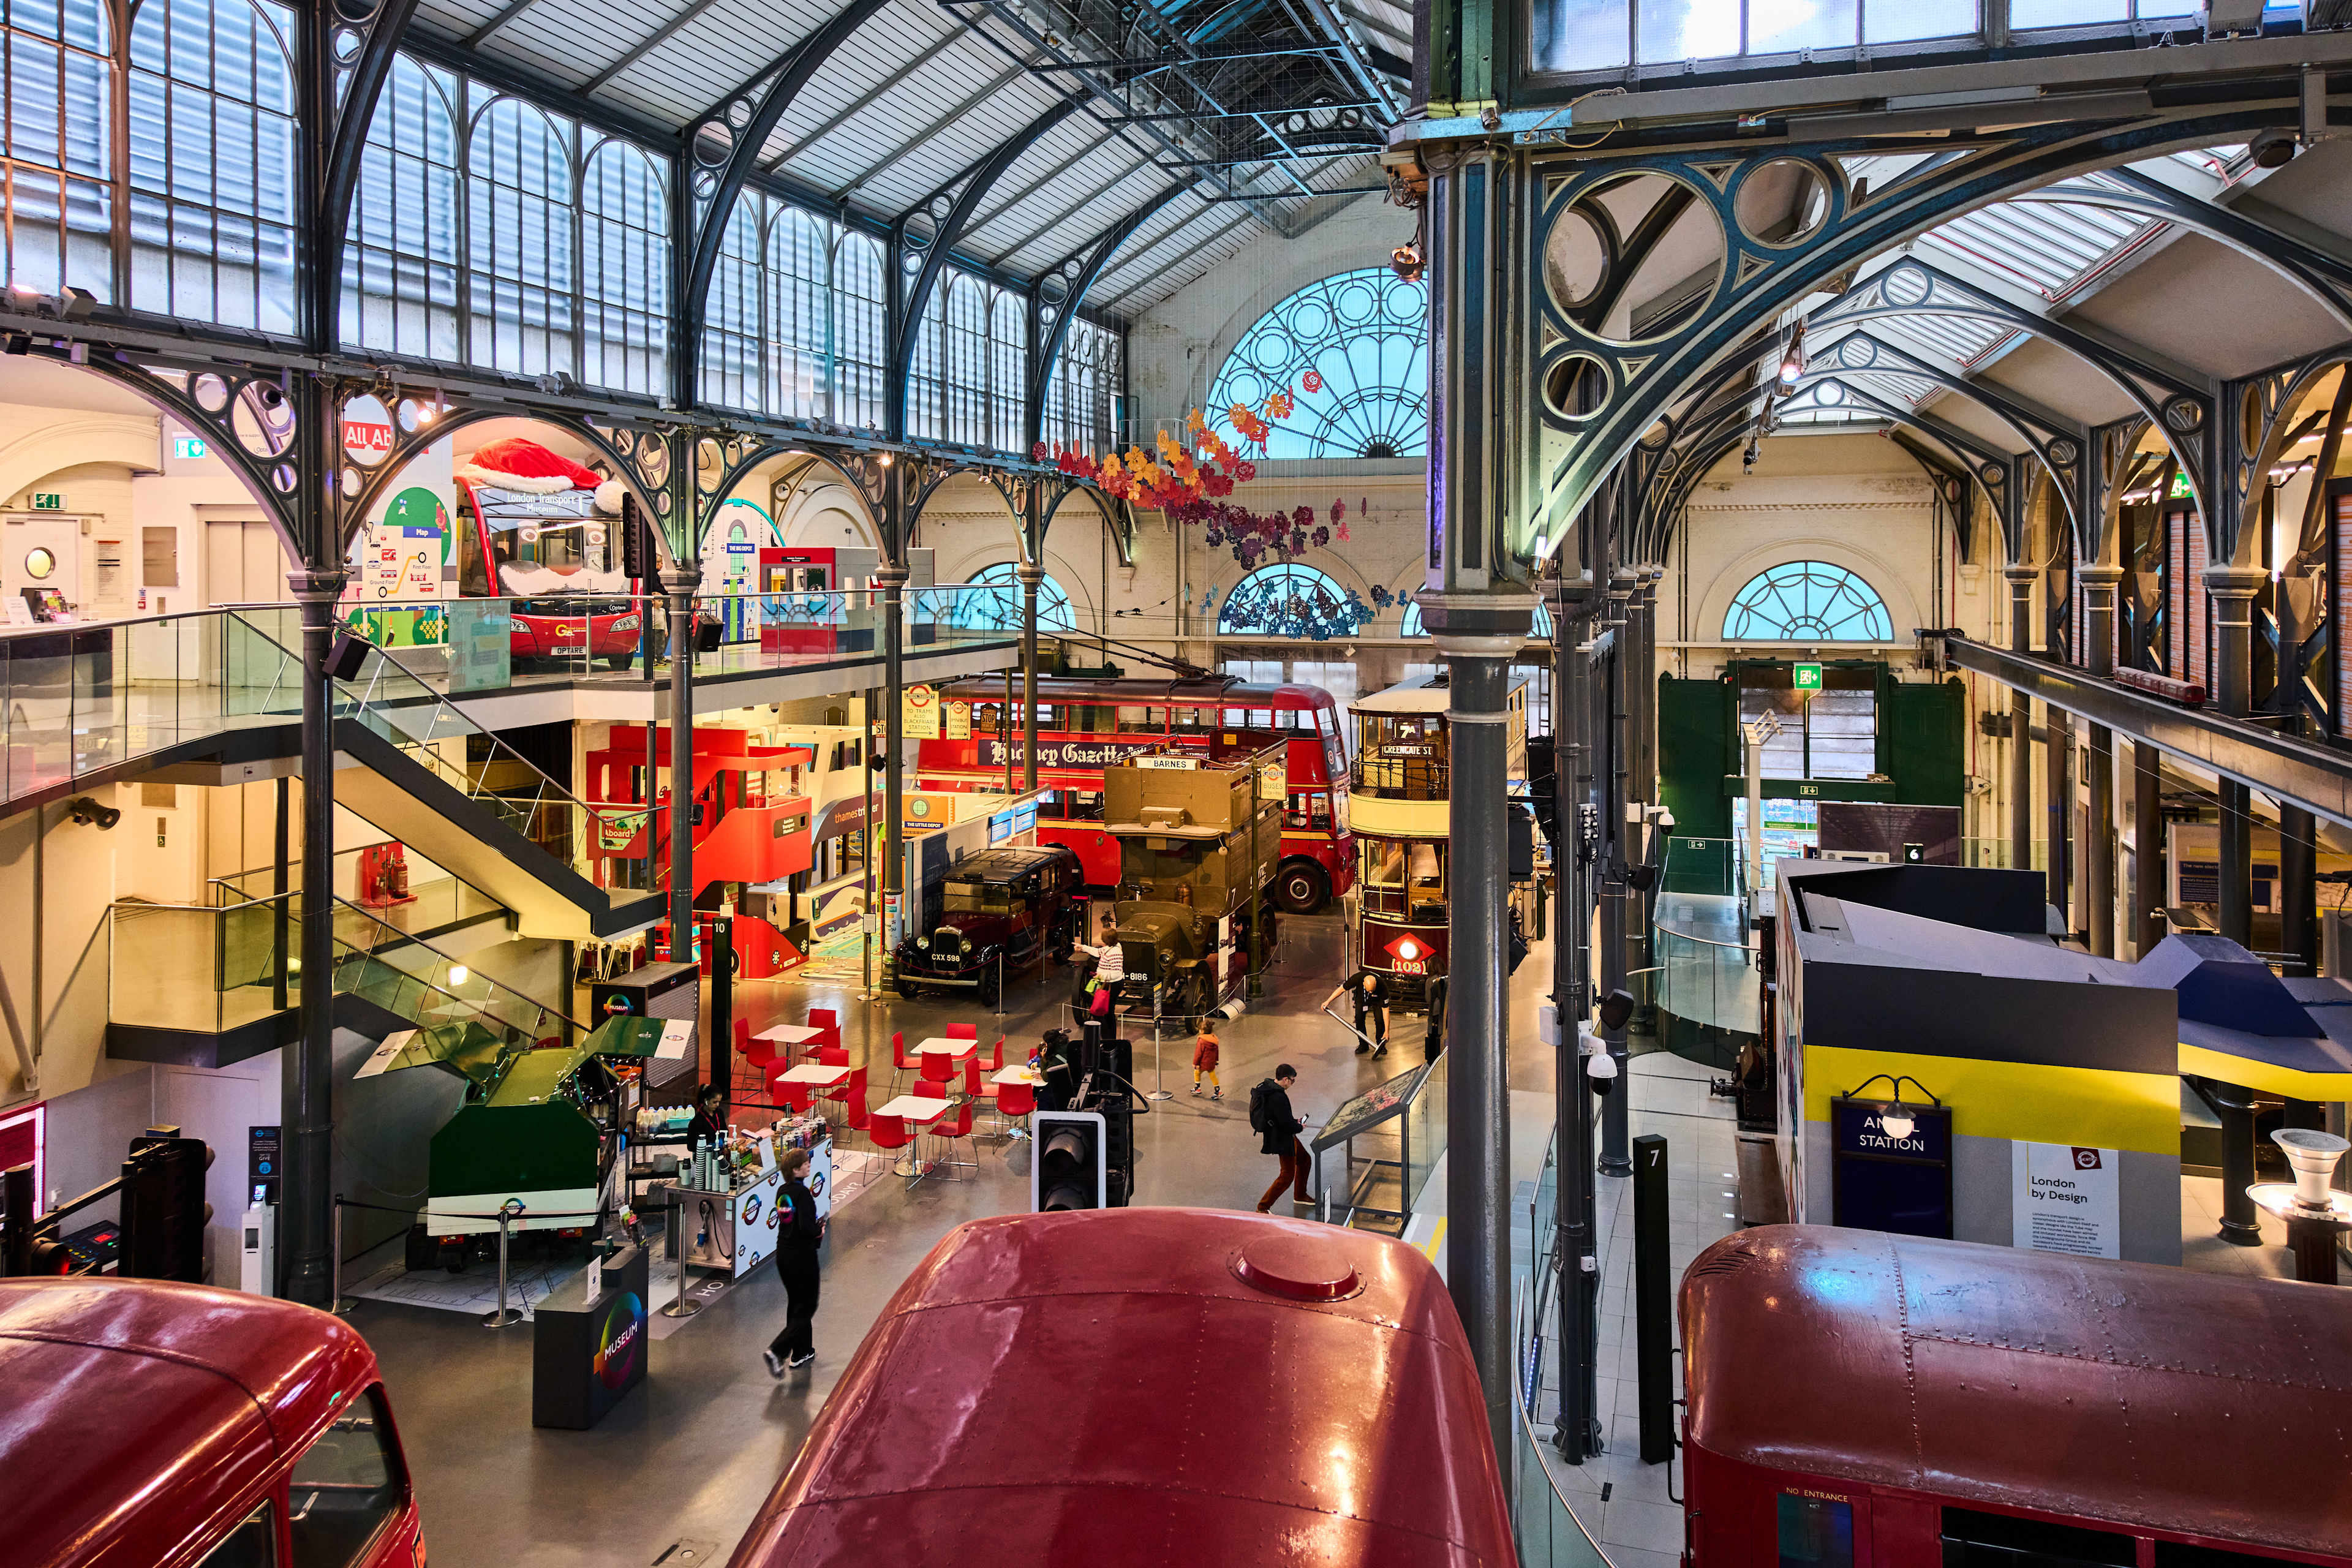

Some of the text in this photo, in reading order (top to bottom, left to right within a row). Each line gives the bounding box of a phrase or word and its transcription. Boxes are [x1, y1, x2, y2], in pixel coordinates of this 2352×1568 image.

[345, 426, 368, 445] All
[507, 493, 576, 505] London Transport
[527, 504, 558, 513] Museum
[982, 714, 995, 723] STOP
[1400, 725, 1416, 739] 7A
[990, 741, 1058, 767] Hacney
[1384, 745, 1421, 755] GREENGATE
[835, 803, 879, 824] thamestrier
[1910, 848, 1919, 860] 6
[715, 922, 725, 933] 10
[1396, 961, 1422, 974] 102
[1864, 1116, 1920, 1133] ANL
[1860, 1134, 1924, 1152] STATION
[1650, 1149, 1660, 1167] 7
[2032, 1176, 2075, 1188] London
[2032, 1189, 2087, 1204] by Design
[605, 1321, 638, 1360] MUSEUM
[1804, 1490, 1848, 1502] ENTRANCE
